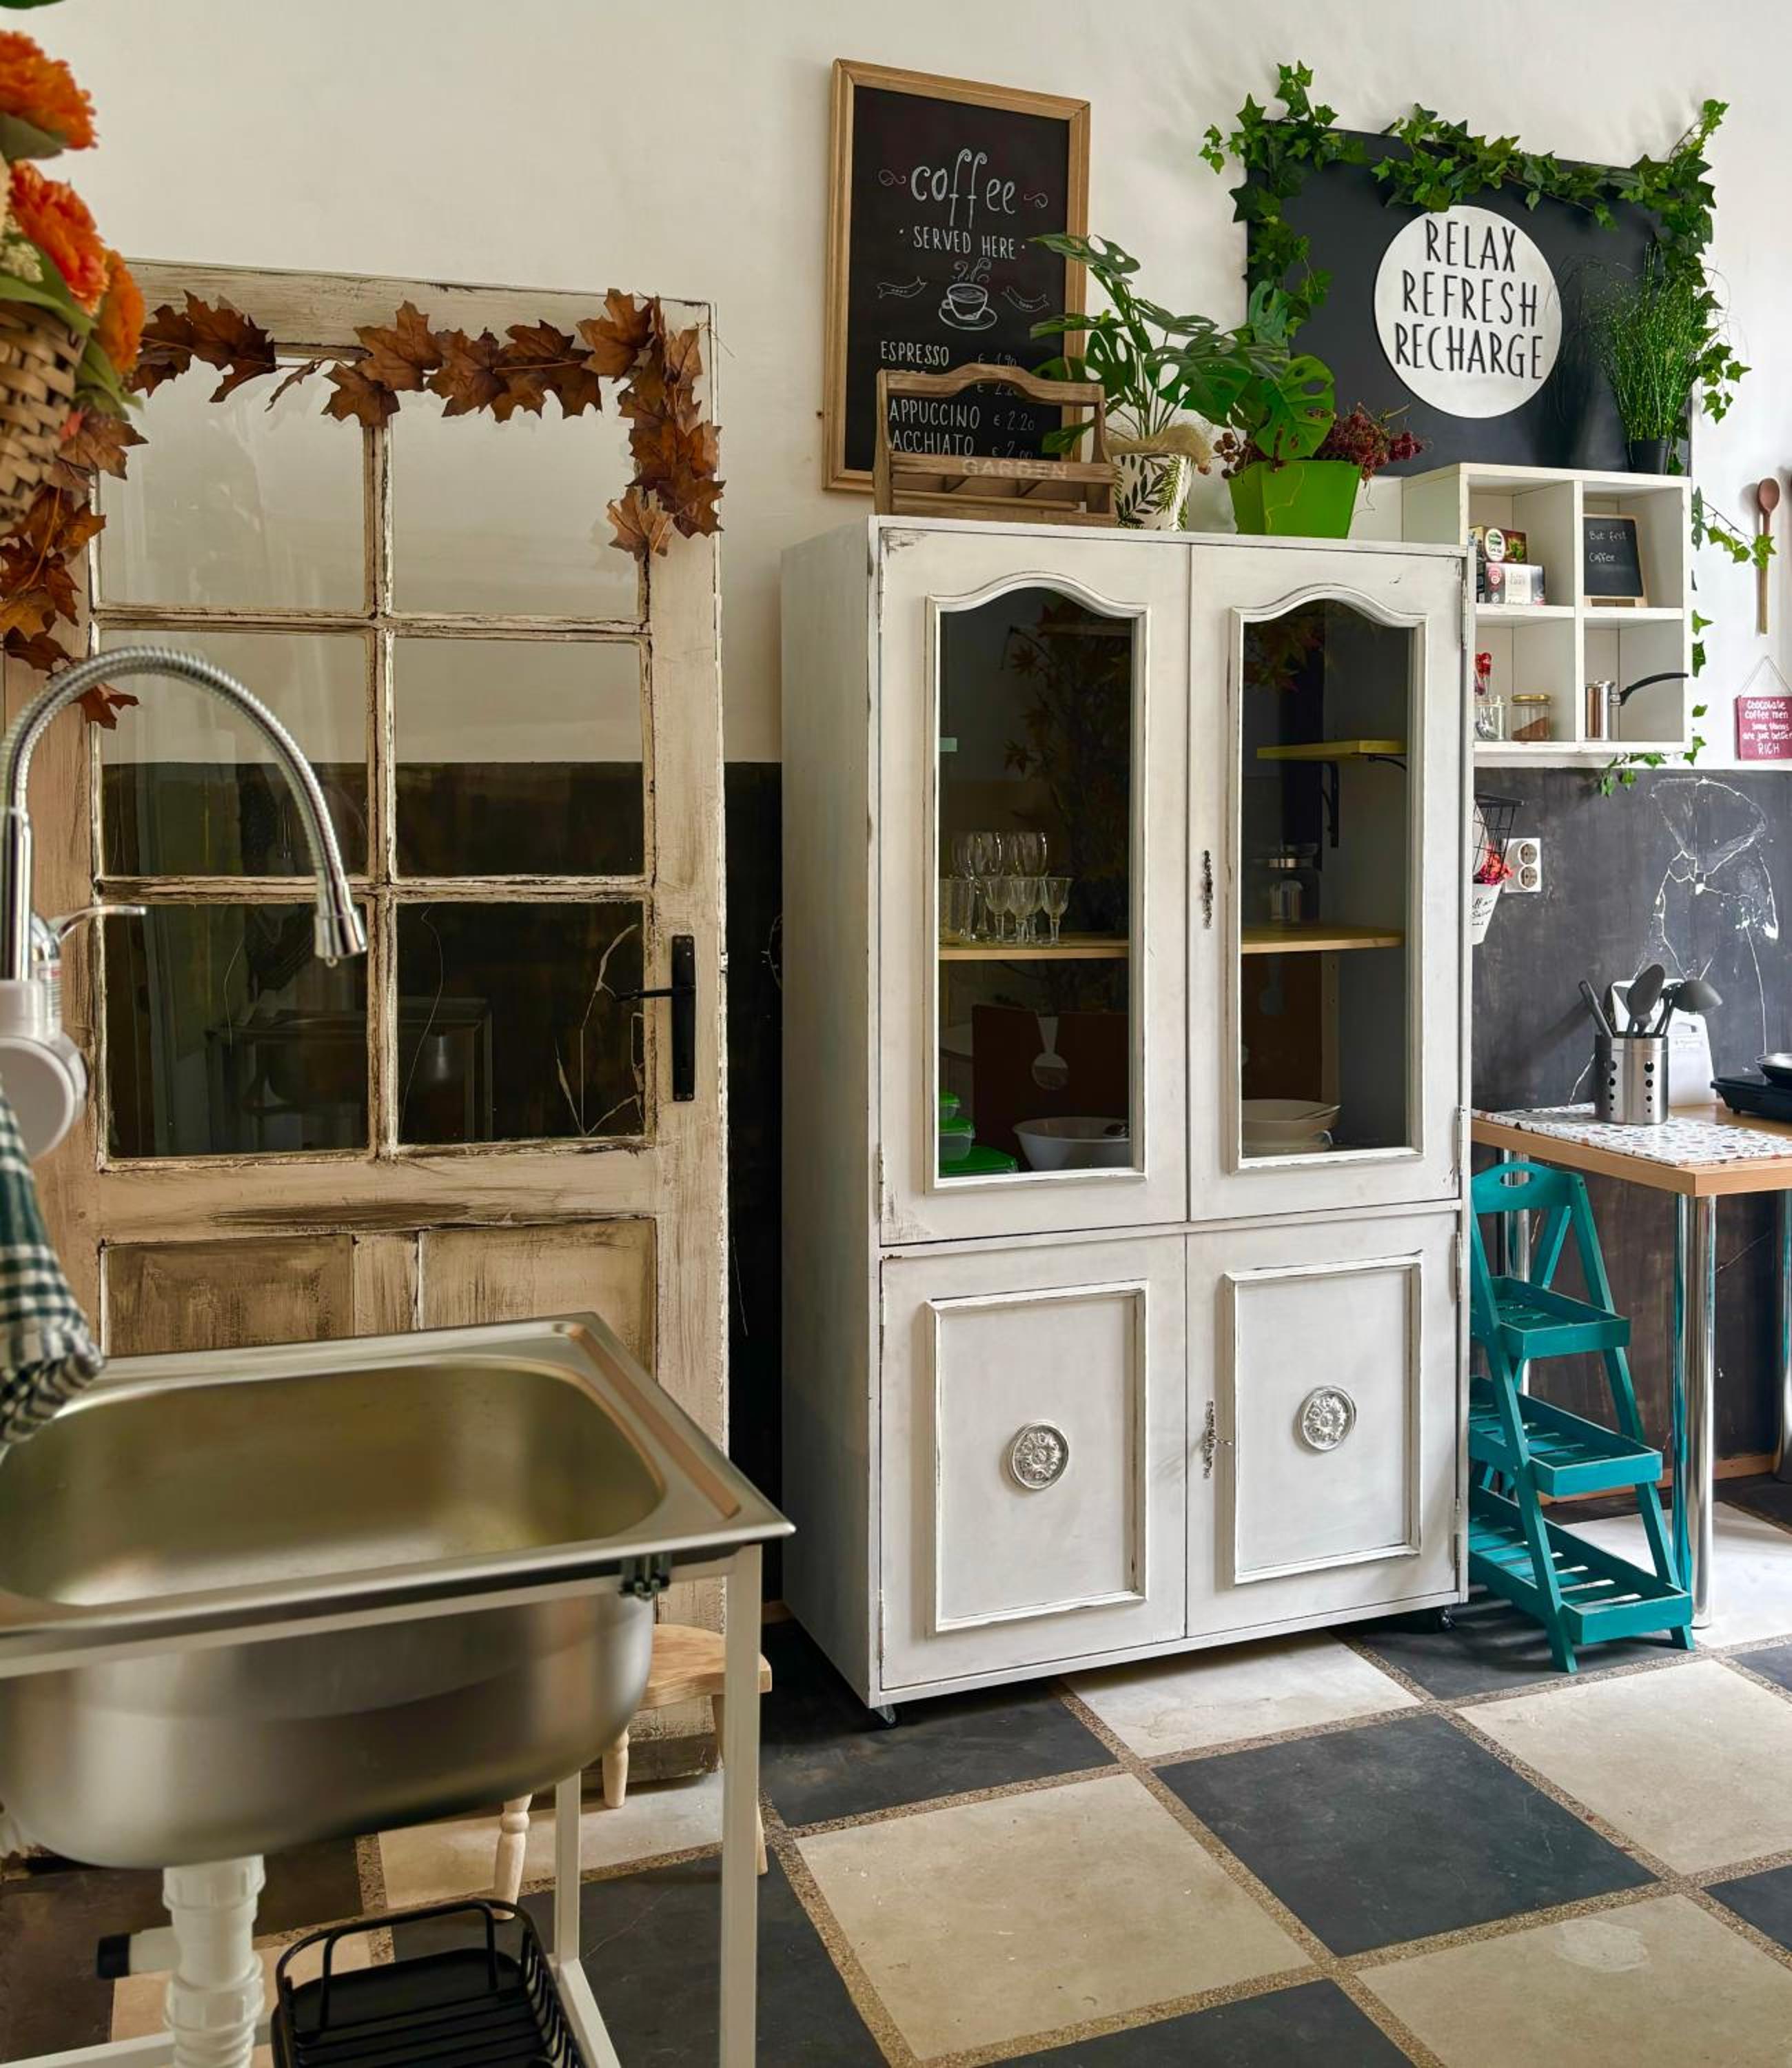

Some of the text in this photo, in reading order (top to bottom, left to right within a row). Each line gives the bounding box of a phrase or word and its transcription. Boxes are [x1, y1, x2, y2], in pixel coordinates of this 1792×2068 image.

[910, 148, 1015, 229] coffee
[913, 225, 1016, 260] SERVED HERE
[1425, 219, 1516, 272] RELAX
[1402, 270, 1537, 327] REFRESH
[881, 341, 950, 367] ESPRESSO
[1395, 322, 1543, 379] RECHARGE
[888, 398, 981, 429] APPUCCINO
[992, 414, 1001, 427] €
[893, 429, 975, 456] ACCHIATO
[1758, 742, 1780, 755] RICH
